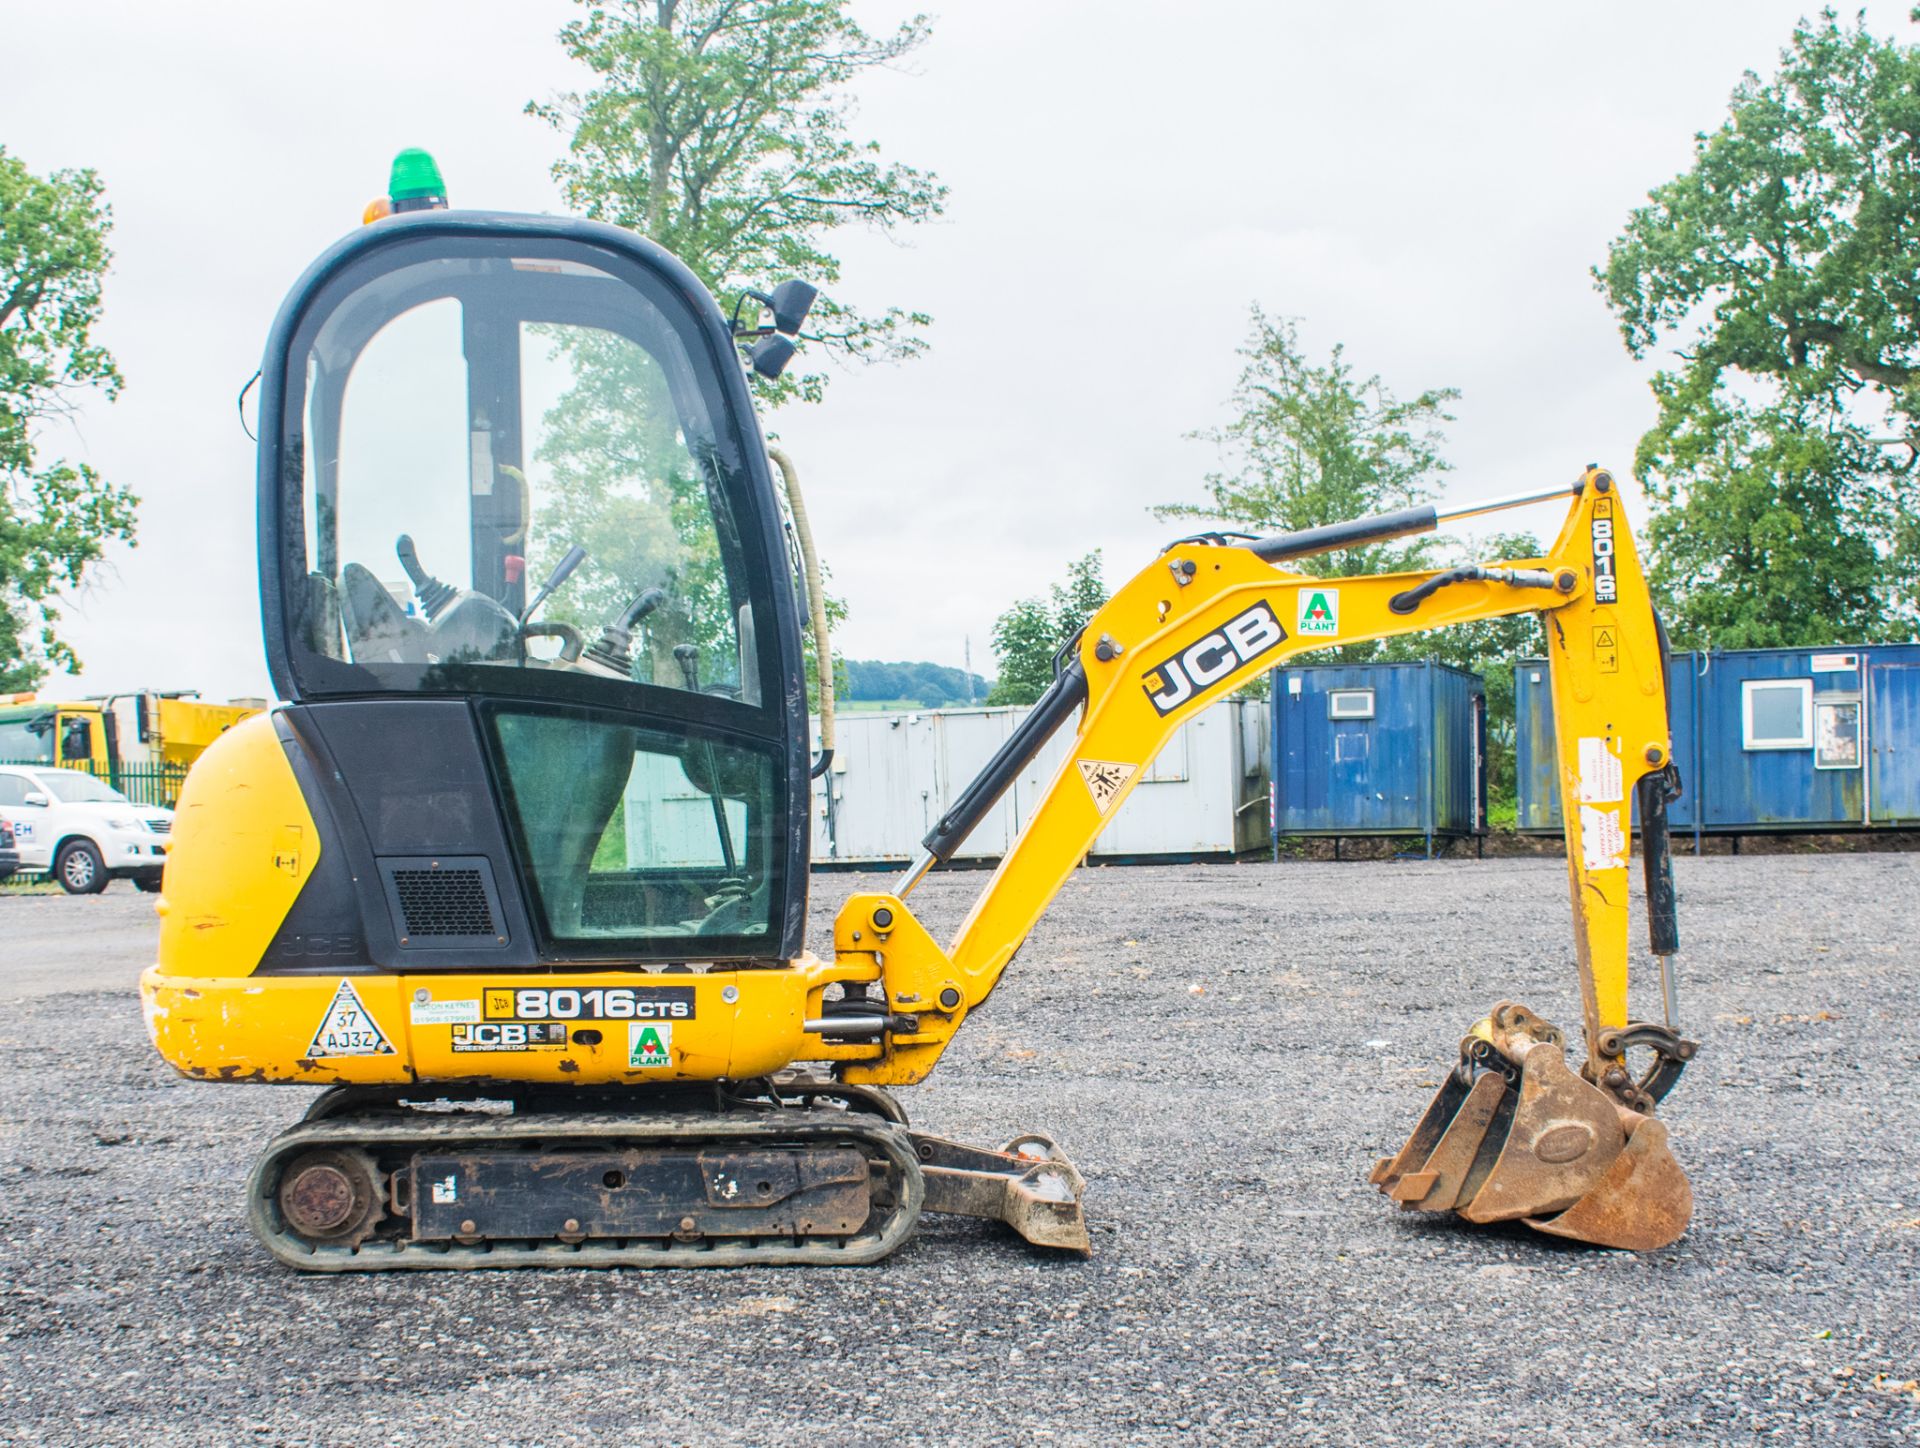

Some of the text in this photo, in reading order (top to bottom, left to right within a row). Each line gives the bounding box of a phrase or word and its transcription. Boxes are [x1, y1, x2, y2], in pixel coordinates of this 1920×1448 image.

[1592, 519, 1616, 594] 8016
[1303, 592, 1334, 620] A
[1300, 622, 1337, 631] PLANT
[1153, 606, 1281, 710] JCB
[493, 996, 509, 1010] JCB
[336, 1011, 357, 1028] 37
[454, 1024, 528, 1044] JCB
[633, 1027, 667, 1055] A
[631, 1057, 669, 1065] PLANT
